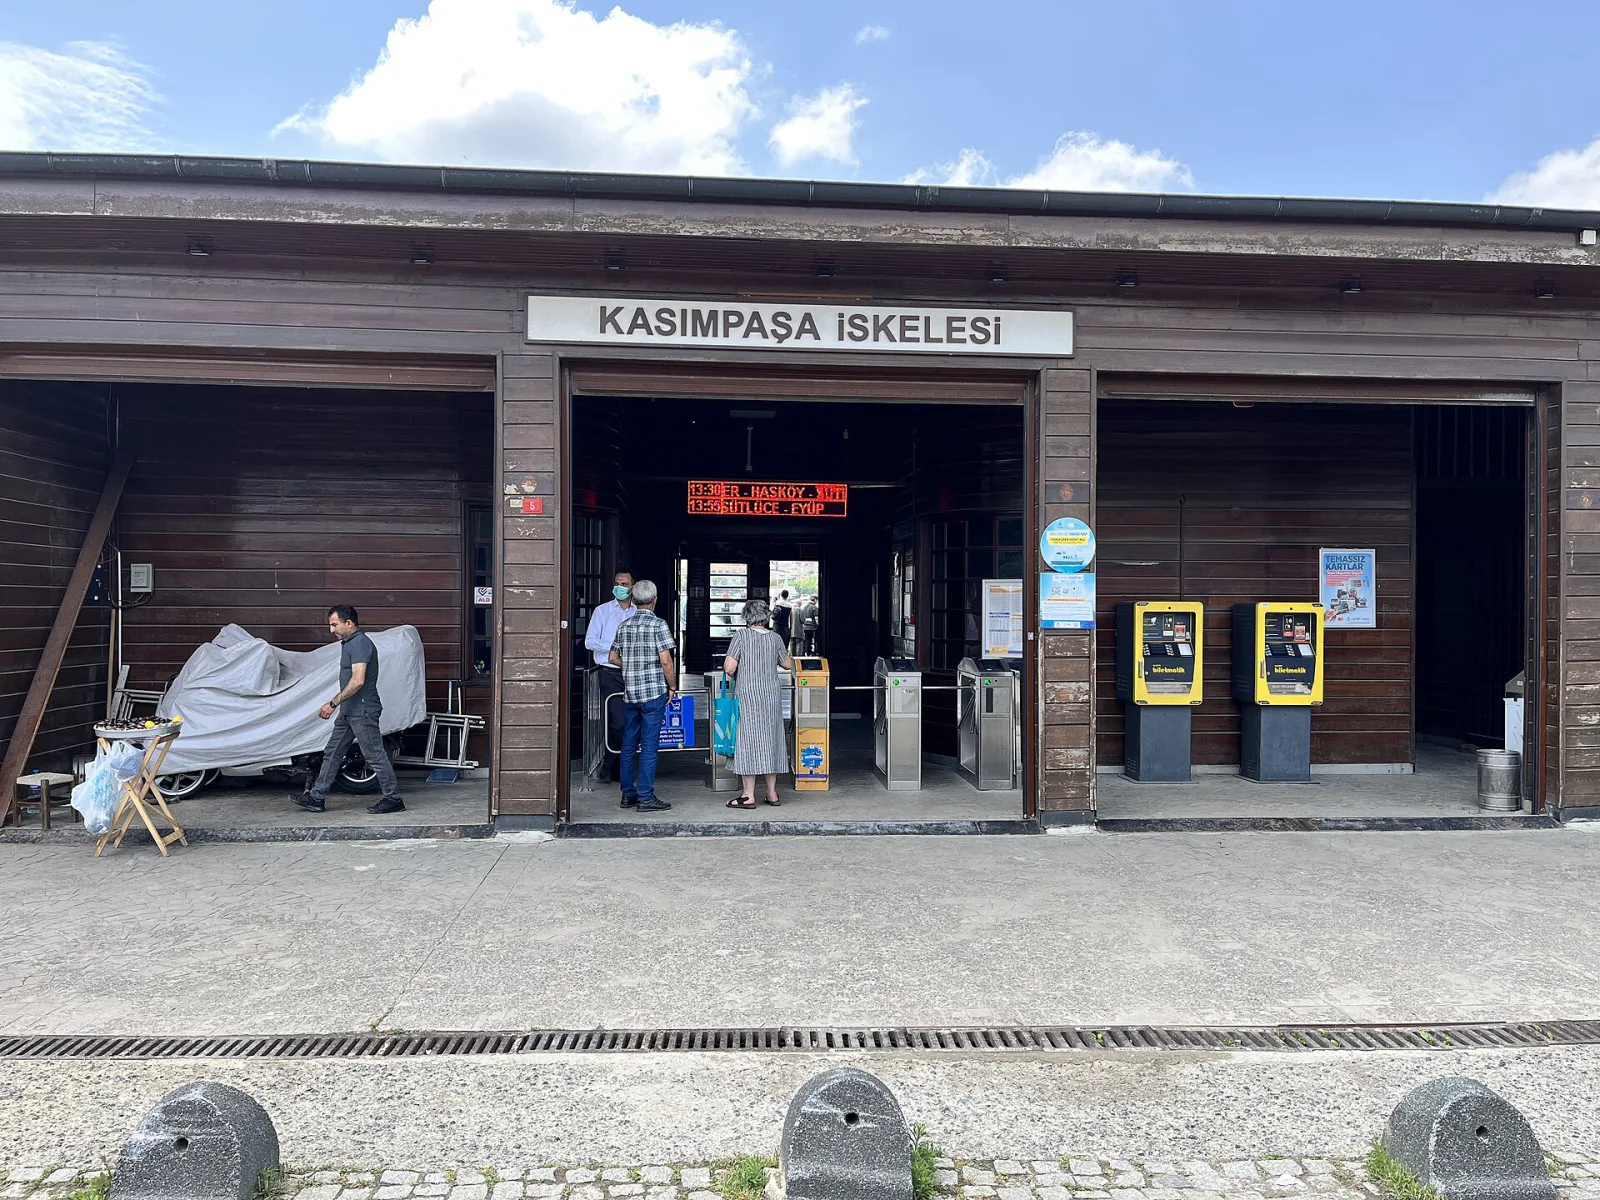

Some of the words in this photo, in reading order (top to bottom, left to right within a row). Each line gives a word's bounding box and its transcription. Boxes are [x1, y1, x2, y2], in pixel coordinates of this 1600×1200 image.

[599, 305, 821, 343] KASIMPAŞA
[837, 312, 1001, 345] İSKELESİ
[690, 483, 720, 496] 13:30
[751, 485, 806, 498] HASKÖY
[529, 501, 536, 511] 5
[690, 499, 720, 511] 13:55
[722, 500, 779, 514] SÜTLÜCE
[791, 501, 825, 515] EYÜP
[1325, 555, 1366, 563] TEMASSIZ
[1325, 563, 1364, 571] KARTLAR
[1152, 666, 1186, 674] biletmatik
